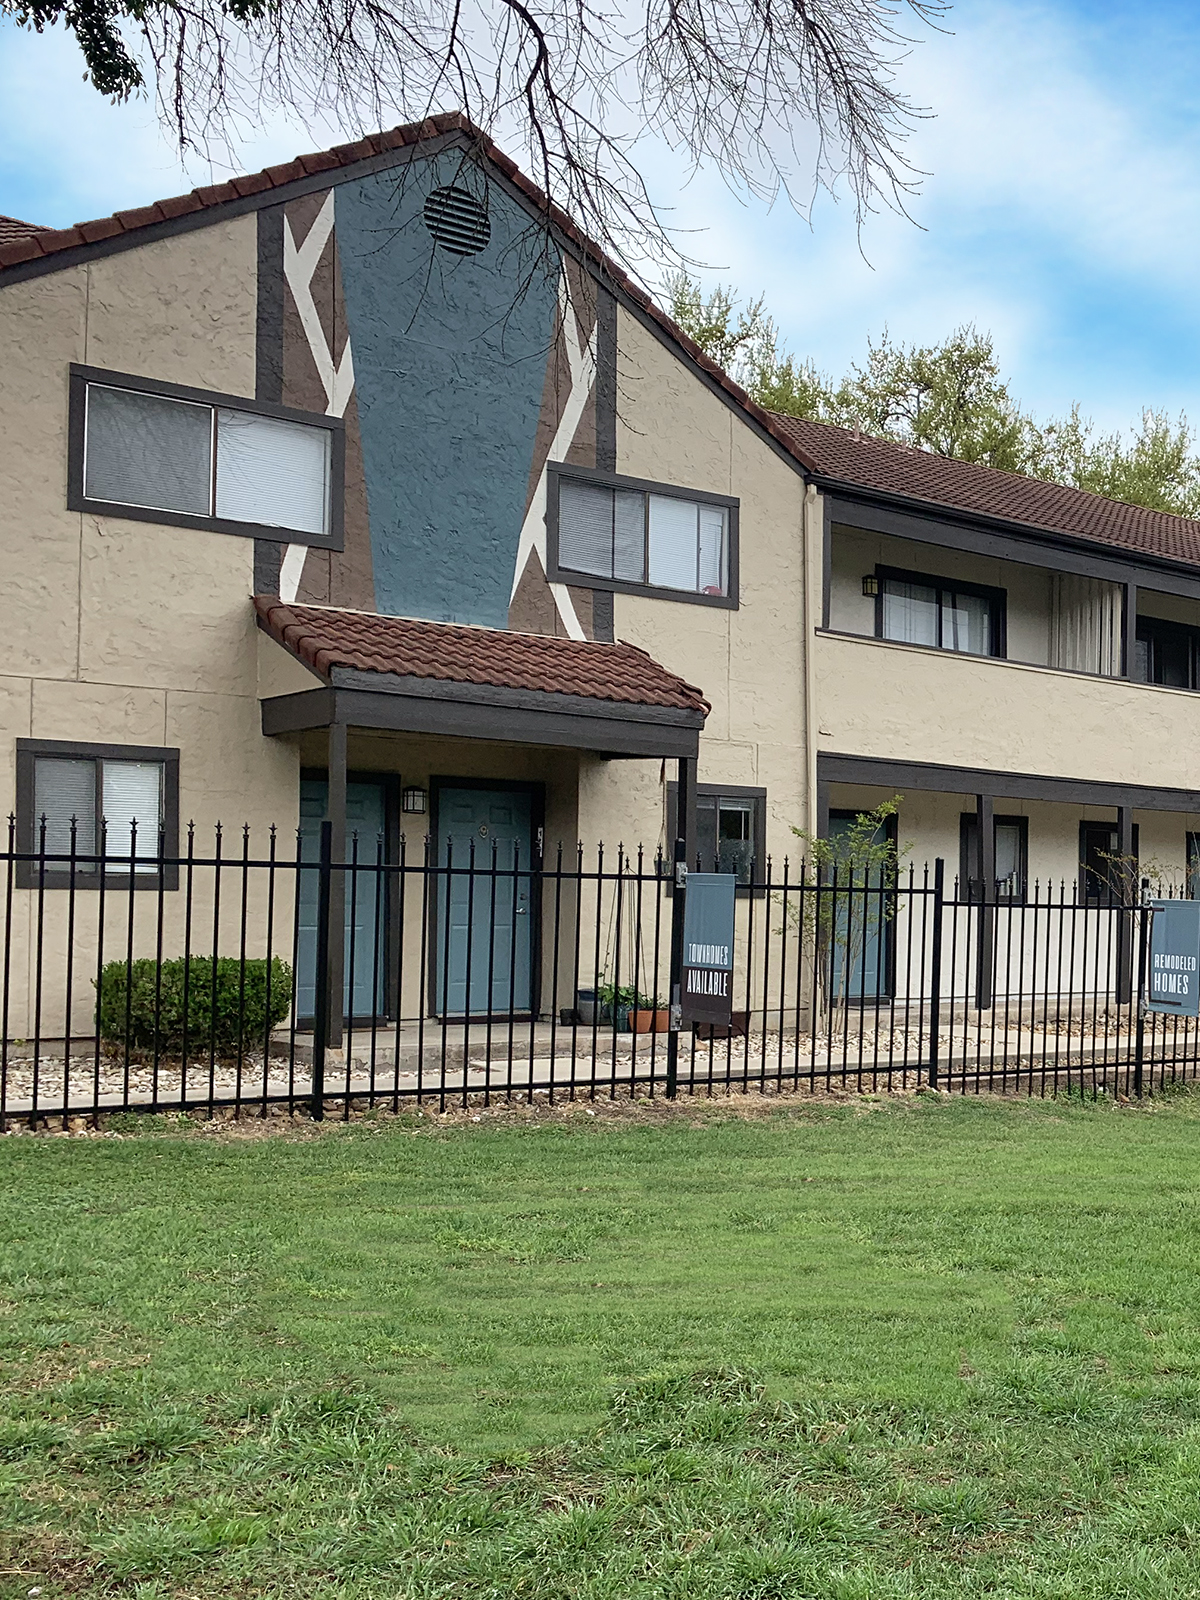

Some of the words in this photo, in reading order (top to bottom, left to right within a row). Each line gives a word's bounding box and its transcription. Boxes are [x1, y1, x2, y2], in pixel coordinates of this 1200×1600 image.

[688, 944, 729, 965] TOWNHOMES
[1154, 953, 1196, 971] REMODELED
[687, 970, 728, 996] AVAILABLE
[1154, 972, 1189, 995] HOMES
